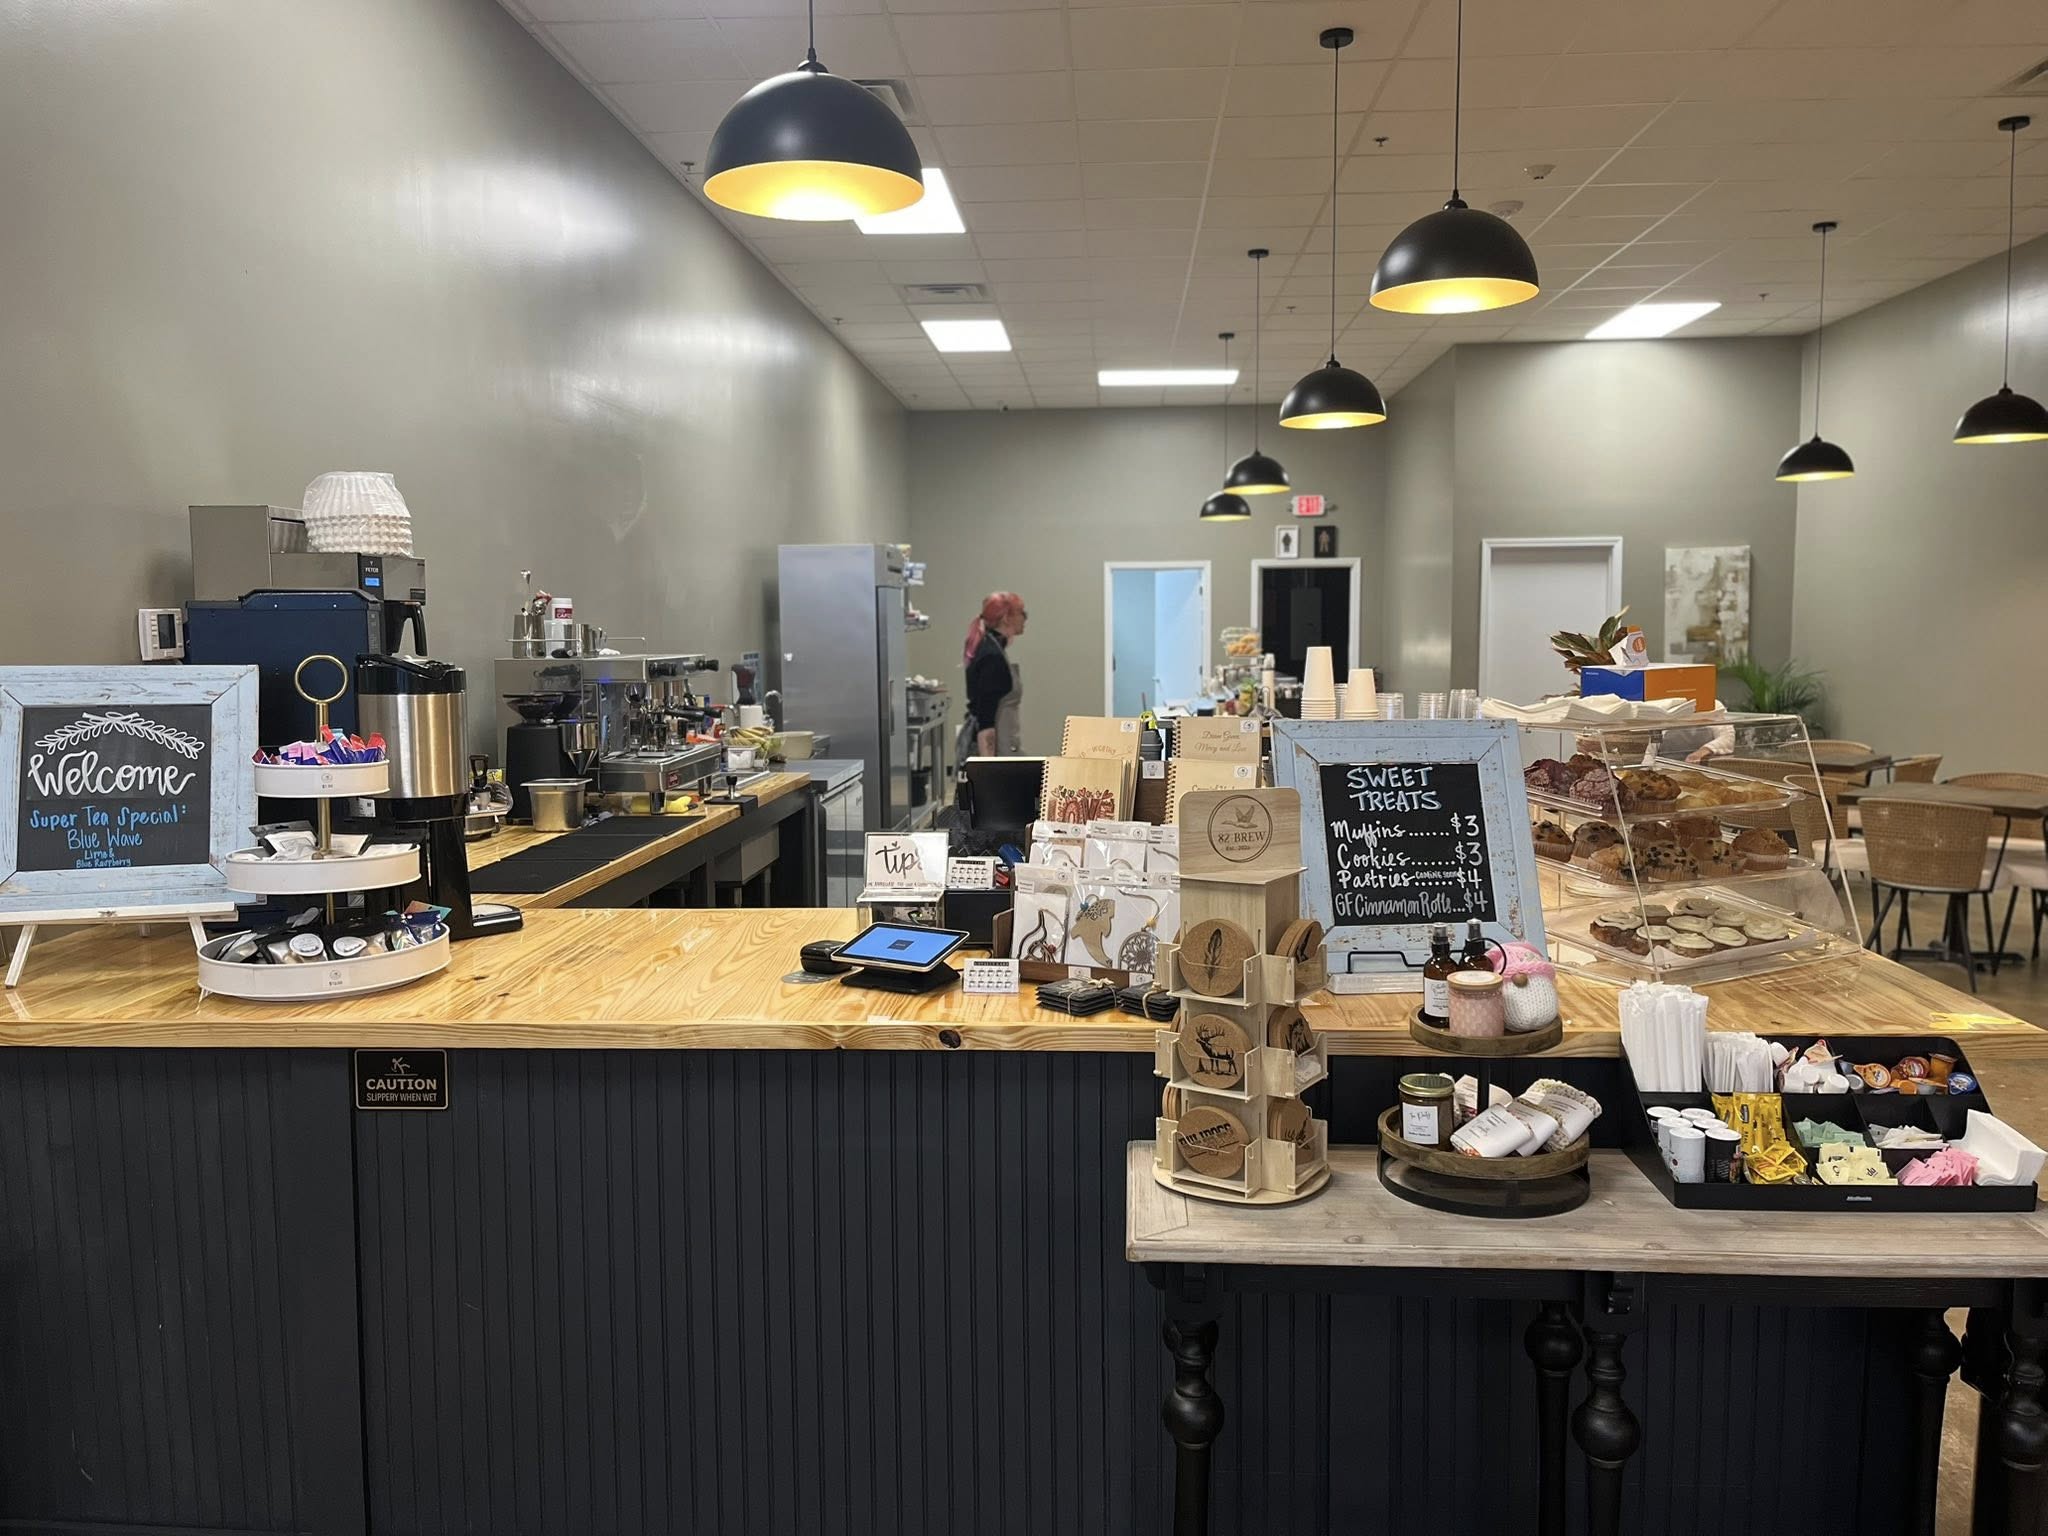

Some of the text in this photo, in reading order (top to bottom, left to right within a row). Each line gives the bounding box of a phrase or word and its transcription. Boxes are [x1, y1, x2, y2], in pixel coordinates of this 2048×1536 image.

[28, 749, 196, 796] Welcome
[1346, 766, 1434, 789] SWEET
[1349, 790, 1442, 812] TREATS
[30, 810, 78, 831] Super
[81, 805, 109, 827] Tea
[67, 828, 143, 850] Blue Wave
[1233, 830, 1267, 843] BREW
[76, 859, 93, 869] Blue
[1335, 892, 1354, 917] GF
[1355, 893, 1420, 918] Cinnamon
[366, 1079, 437, 1090] CAUTION
[366, 1092, 437, 1102] SLIPPERY WHEN WET
